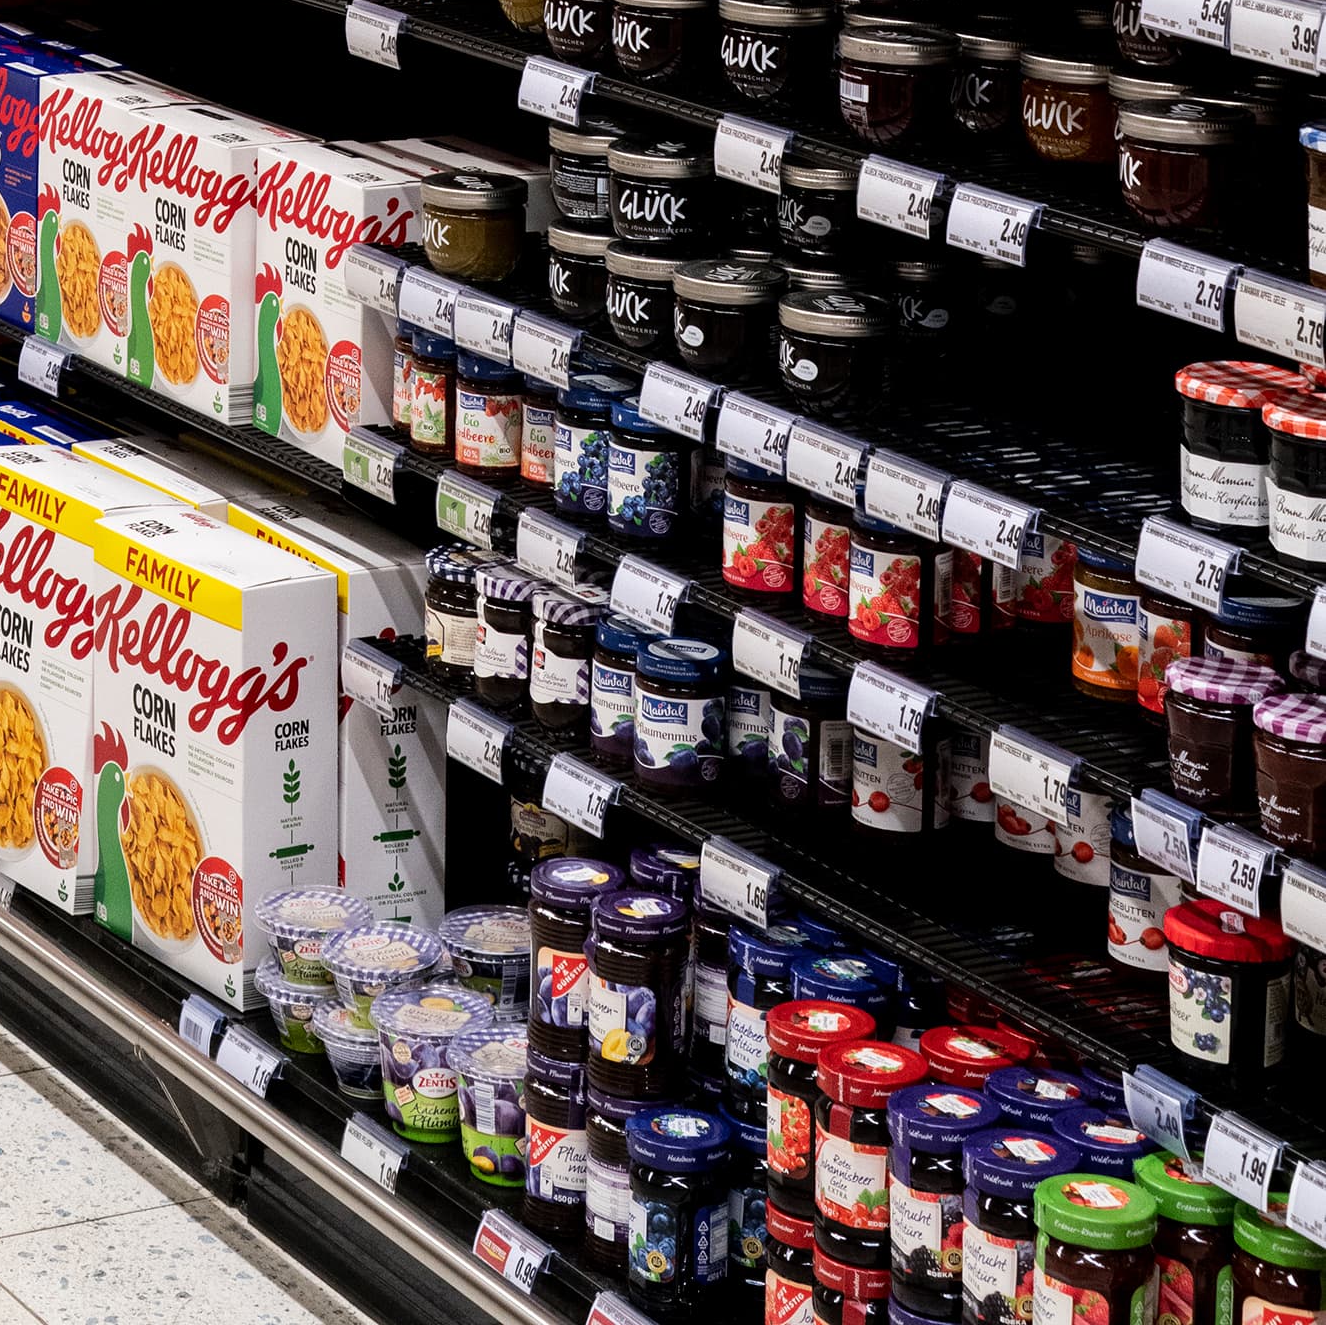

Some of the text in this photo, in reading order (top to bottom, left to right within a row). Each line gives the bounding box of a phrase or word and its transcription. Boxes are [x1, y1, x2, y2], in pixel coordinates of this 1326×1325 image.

[721, 33, 780, 73] GLÜCK
[1292, 24, 1318, 53] 3.99
[1023, 94, 1086, 134] GLÜCK
[63, 157, 90, 190] CORN
[155, 197, 186, 232] CORN
[619, 187, 686, 222] GLÜCK
[908, 192, 931, 222] 2.49
[155, 223, 186, 252] FLAKES
[285, 236, 317, 273] CORN
[285, 267, 316, 295] FLAKES
[1195, 280, 1223, 311] 2.79
[437, 297, 453, 323] 2.49
[1296, 316, 1324, 348] 2.79
[552, 347, 569, 372] 2.49
[376, 464, 393, 488] 2.29
[835, 461, 856, 489] 2.49
[997, 519, 1021, 550] 2.49
[125, 547, 200, 603] FAMILY
[556, 550, 575, 574] 2.29
[1085, 596, 1134, 616] Maintal
[1085, 623, 1132, 643] Aprikose
[778, 652, 799, 682] 1.79
[132, 684, 176, 732] CORN
[642, 697, 685, 721] Maintal
[898, 702, 921, 735] 1.79
[132, 715, 176, 758] FLAKES
[274, 719, 310, 739] CORN
[274, 734, 310, 751] FLAKES
[484, 740, 502, 768] 2.29
[1043, 775, 1067, 809] 1.79
[41, 797, 77, 824] AND WIN
[1230, 859, 1256, 893] 2.59
[199, 887, 239, 919] AND WIN
[745, 879, 766, 912] 1.69
[252, 1061, 272, 1092] 1.19
[417, 1075, 457, 1090] ZENTIS
[1090, 1155, 1124, 1167] Waldfrucht
[1240, 1152, 1267, 1187] 1.99
[378, 1161, 397, 1193] 1.99
[514, 1257, 536, 1287] 0.99
